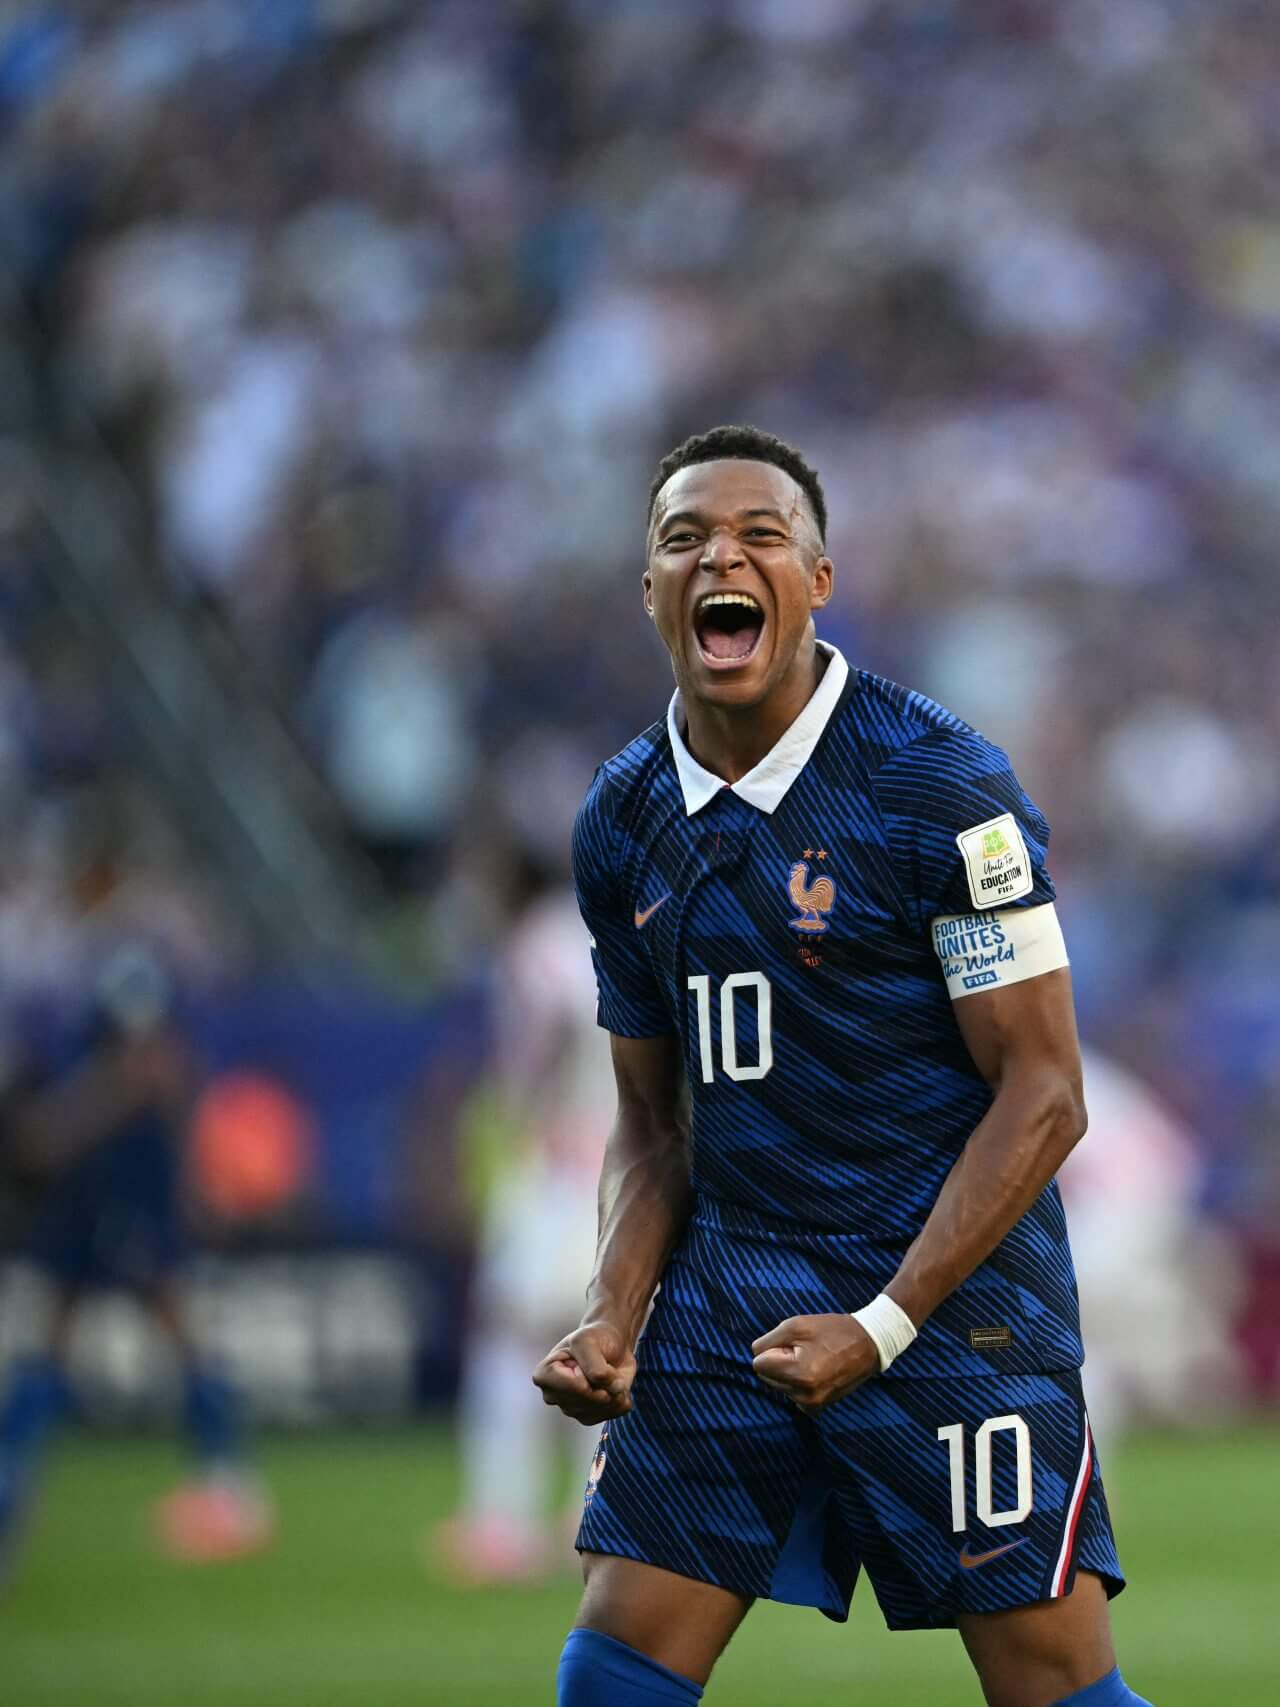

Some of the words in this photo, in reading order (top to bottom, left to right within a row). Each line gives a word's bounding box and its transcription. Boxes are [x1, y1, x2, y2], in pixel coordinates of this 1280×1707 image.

[980, 865, 1022, 891] EDUCATION
[997, 884, 1014, 895] FIFA
[934, 911, 1000, 939] FOOTBALL
[937, 924, 1006, 960] UNITES
[943, 960, 963, 979] the
[963, 943, 1015, 972] World
[965, 973, 996, 987] FIFA
[687, 971, 774, 1084] 10
[937, 1414, 1033, 1533] 10
